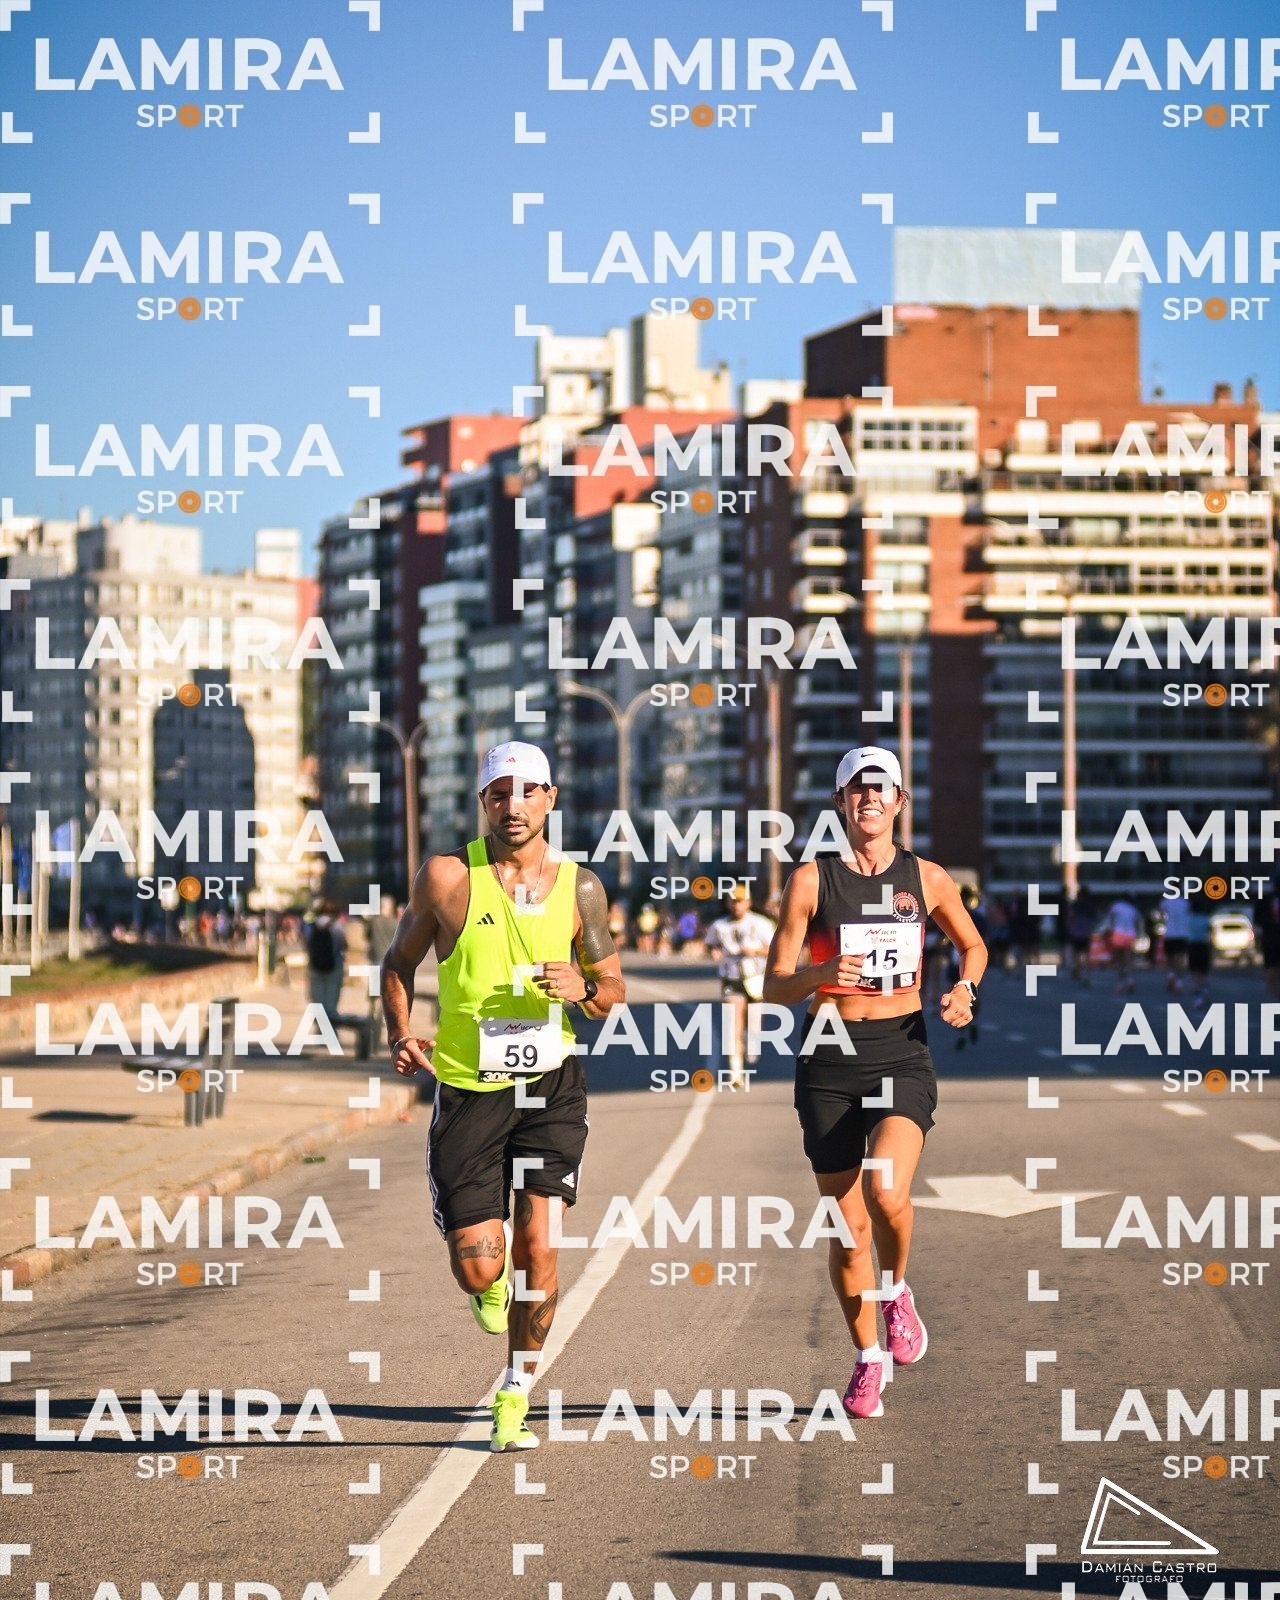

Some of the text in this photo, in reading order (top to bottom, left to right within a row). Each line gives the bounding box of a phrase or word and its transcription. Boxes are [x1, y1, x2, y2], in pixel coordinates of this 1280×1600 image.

[866, 949, 898, 973] 15
[503, 1044, 538, 1068] 59
[482, 1071, 512, 1083] 30K
